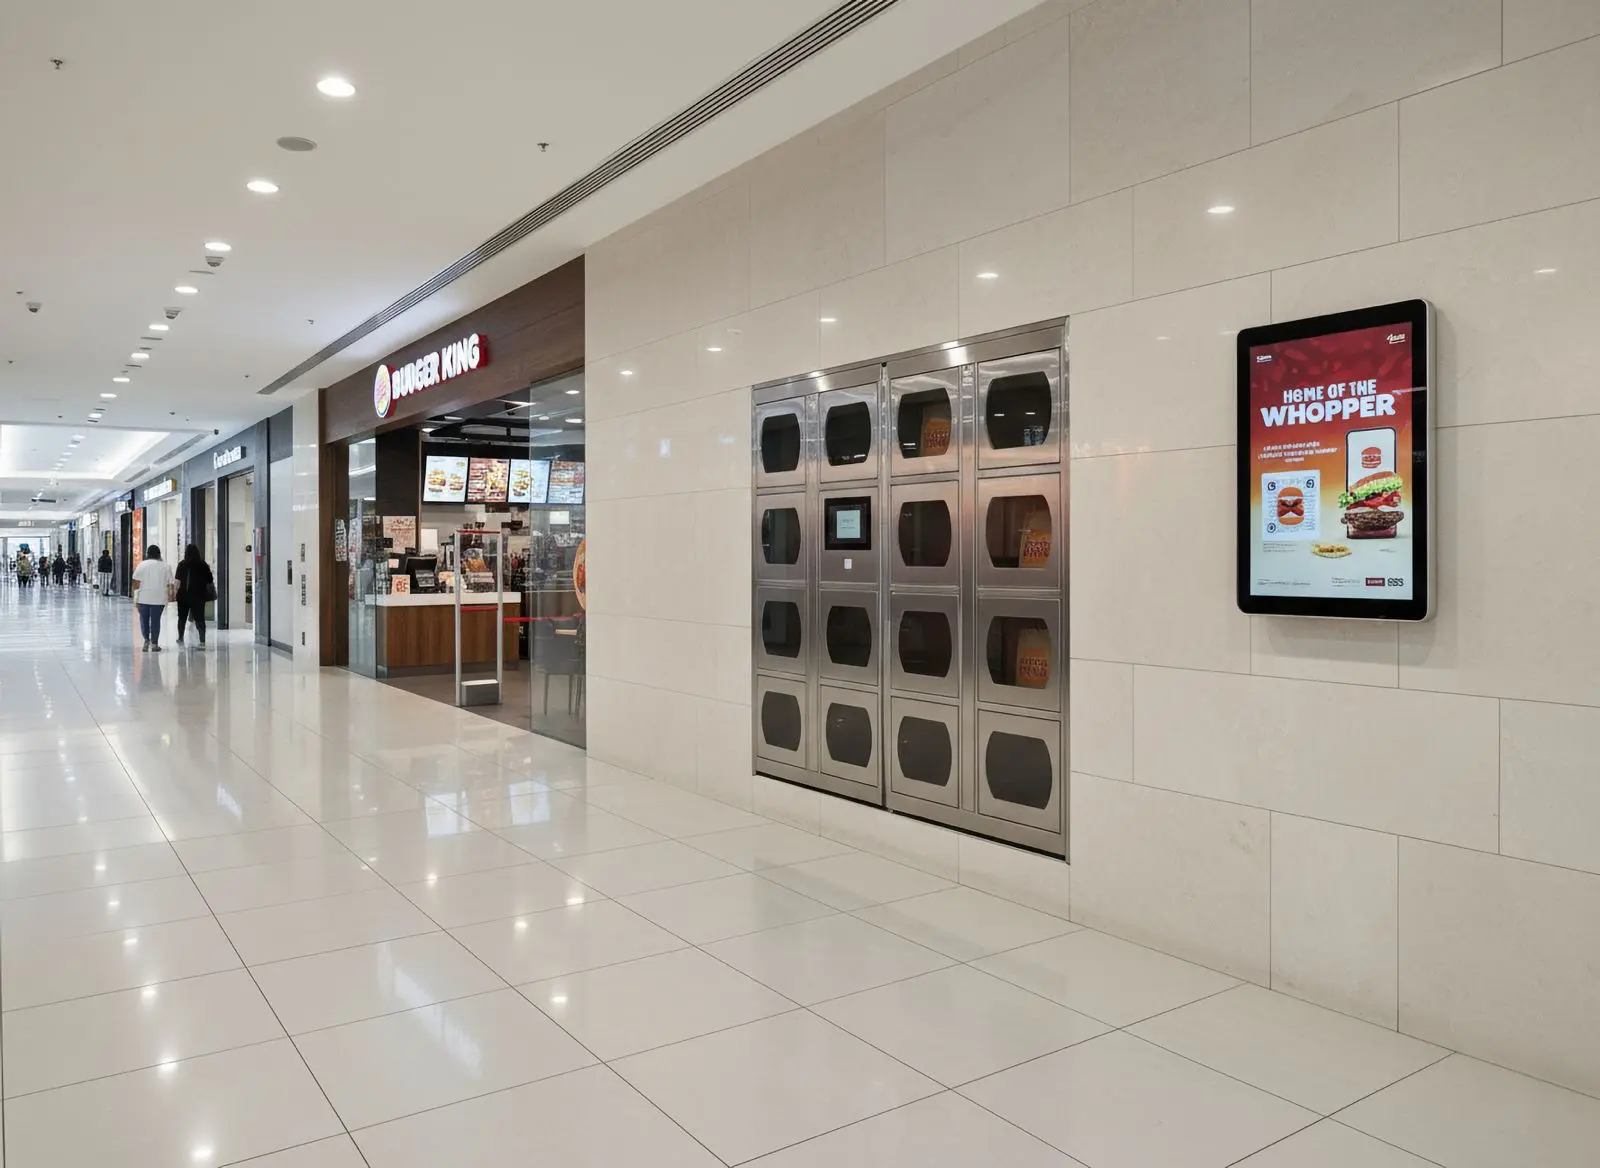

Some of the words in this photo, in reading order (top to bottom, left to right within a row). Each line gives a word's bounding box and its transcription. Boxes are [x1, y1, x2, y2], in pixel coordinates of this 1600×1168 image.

[442, 333, 480, 382] KING
[1327, 382, 1346, 399] OF
[1348, 379, 1377, 397] THE
[1260, 394, 1396, 427] WHOPPER
